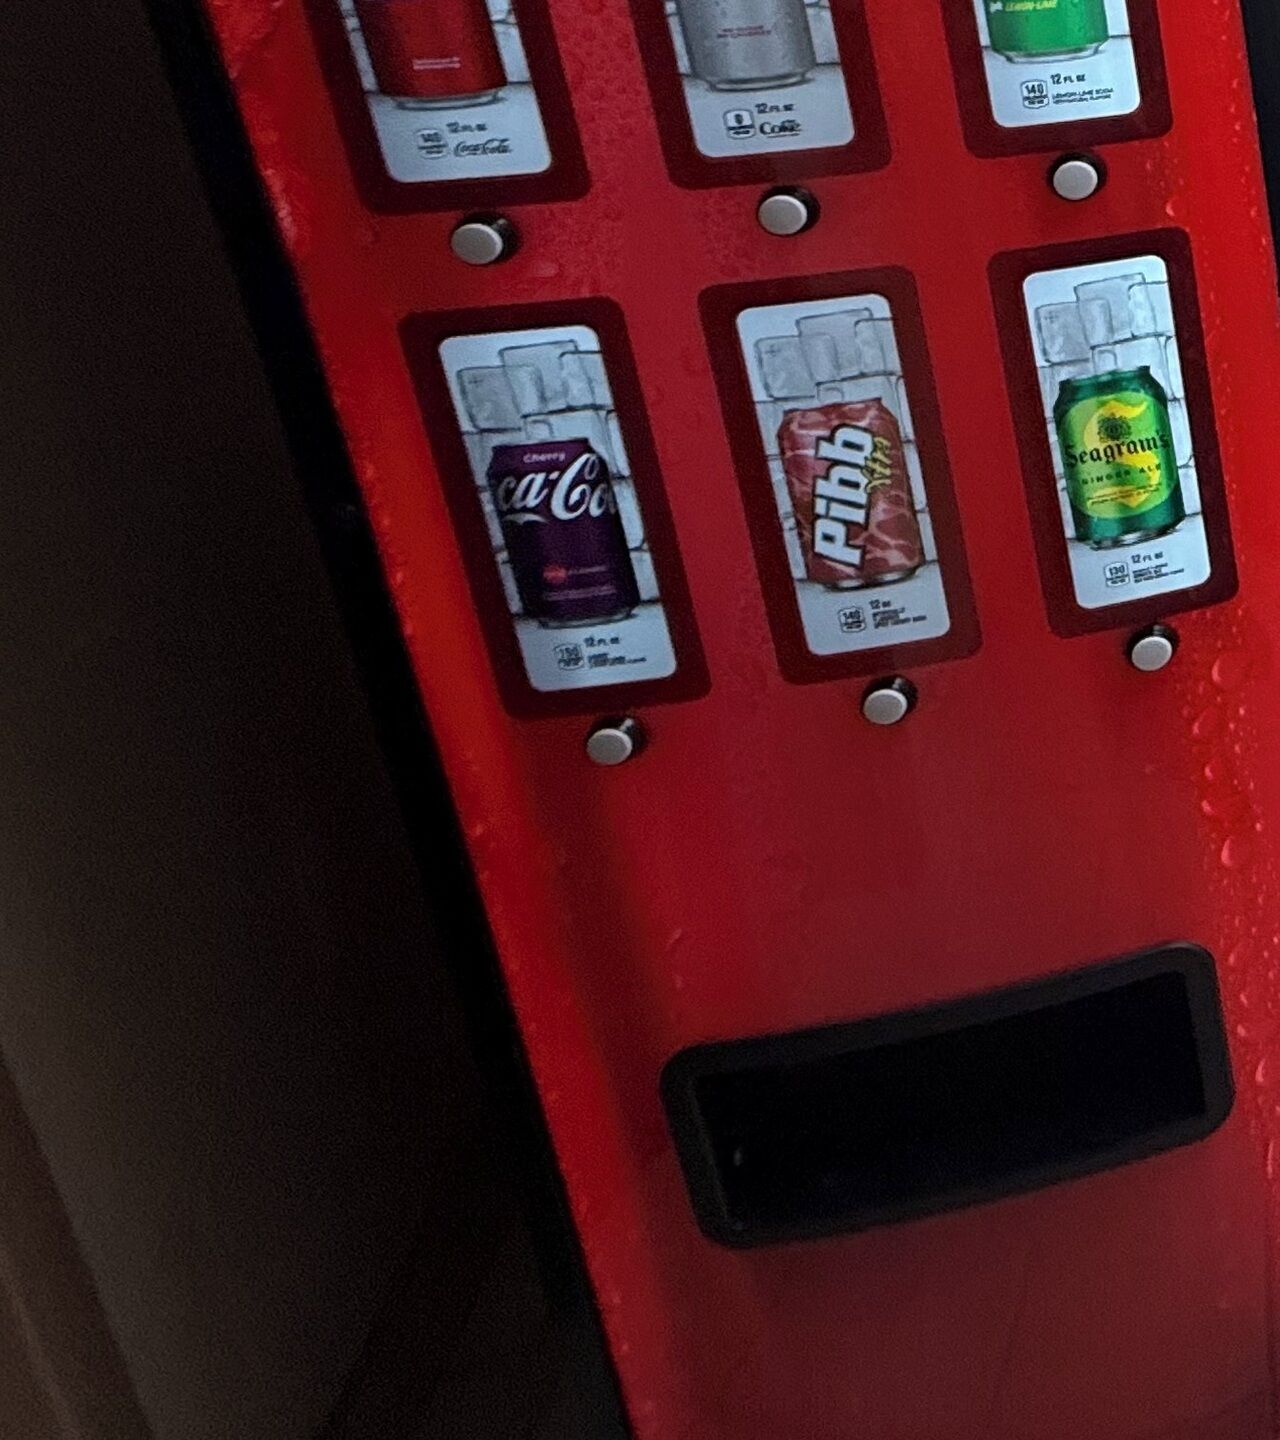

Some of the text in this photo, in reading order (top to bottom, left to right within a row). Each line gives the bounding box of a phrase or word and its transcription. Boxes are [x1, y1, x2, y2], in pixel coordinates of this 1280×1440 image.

[1050, 73, 1062, 85] 12
[1025, 83, 1044, 95] 140
[755, 103, 768, 114] 12
[1064, 429, 1170, 468] Seagram's
[523, 452, 566, 463] Cherry
[815, 425, 874, 565] Pibb
[1131, 554, 1141, 564] 12
[869, 599, 880, 609] 12
